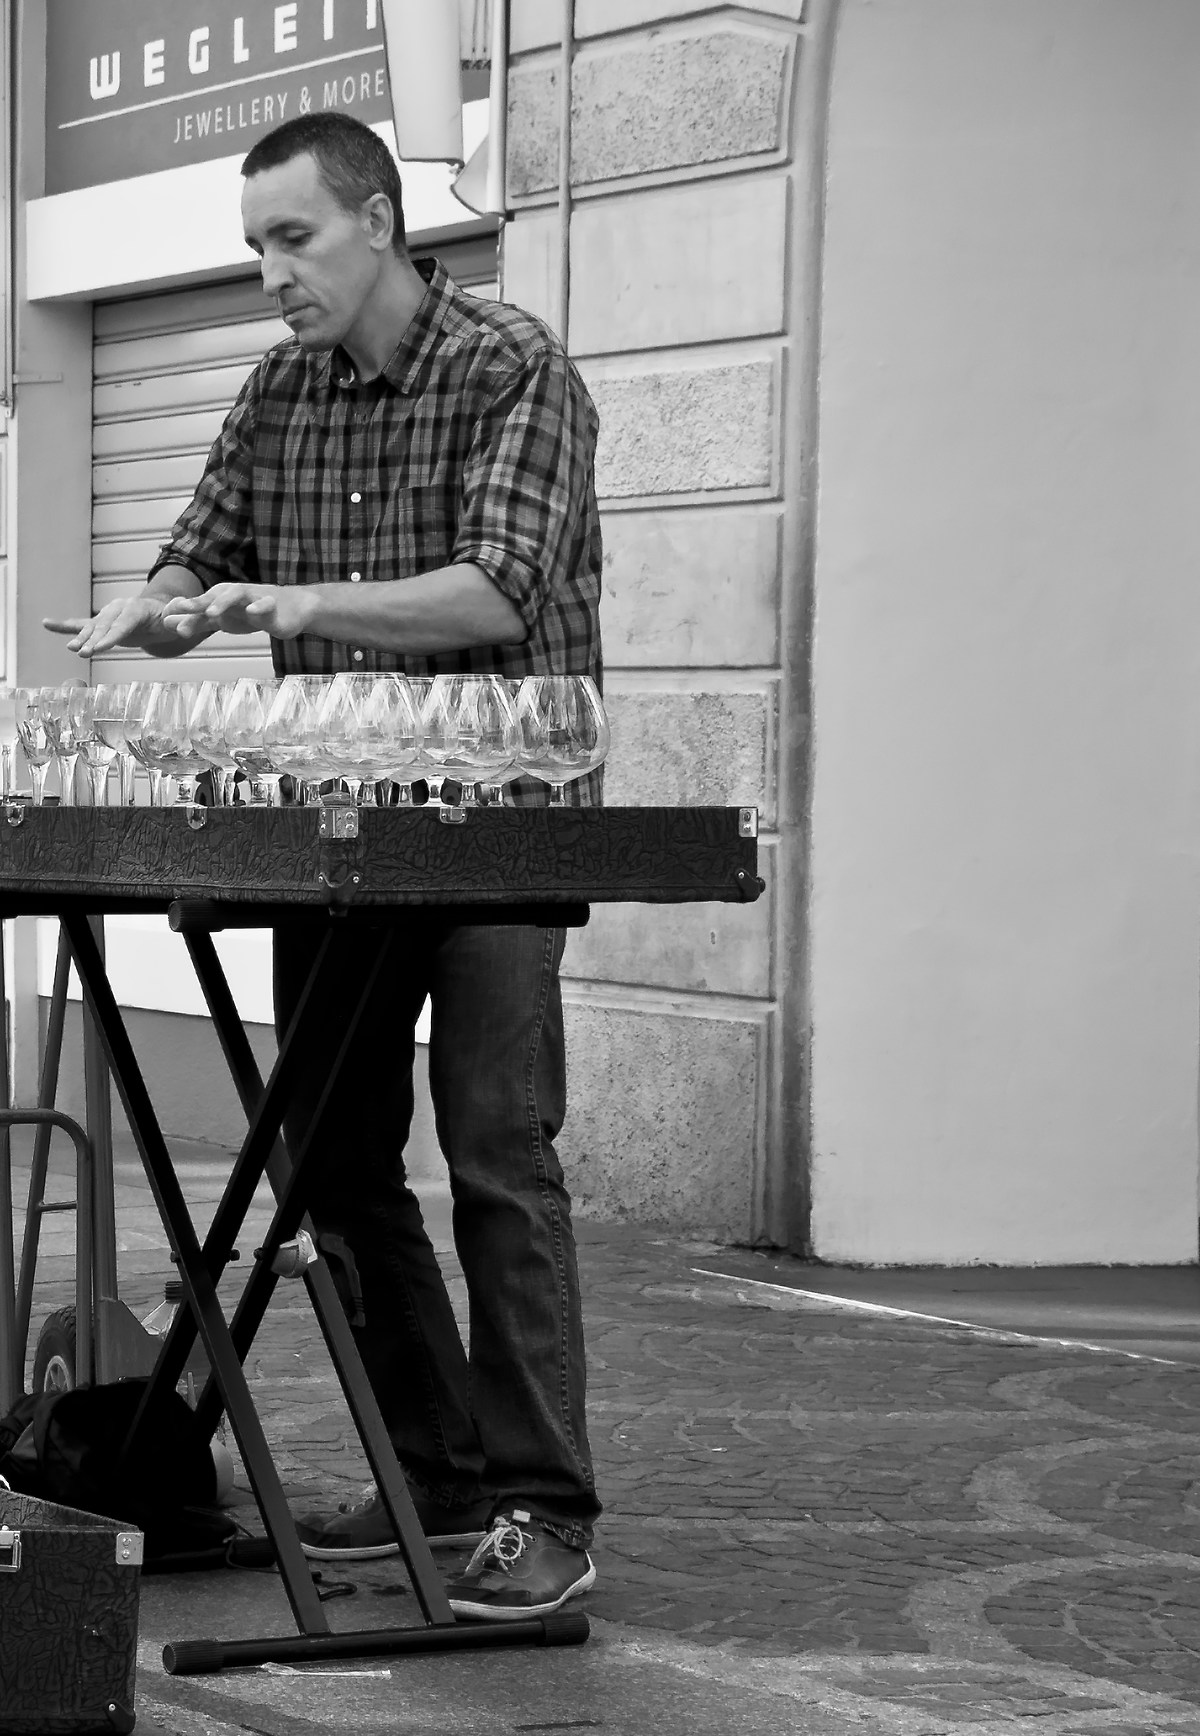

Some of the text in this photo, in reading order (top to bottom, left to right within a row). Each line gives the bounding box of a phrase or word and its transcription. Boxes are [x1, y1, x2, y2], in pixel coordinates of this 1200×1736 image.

[174, 69, 385, 143] JEWELLERY & MORE
